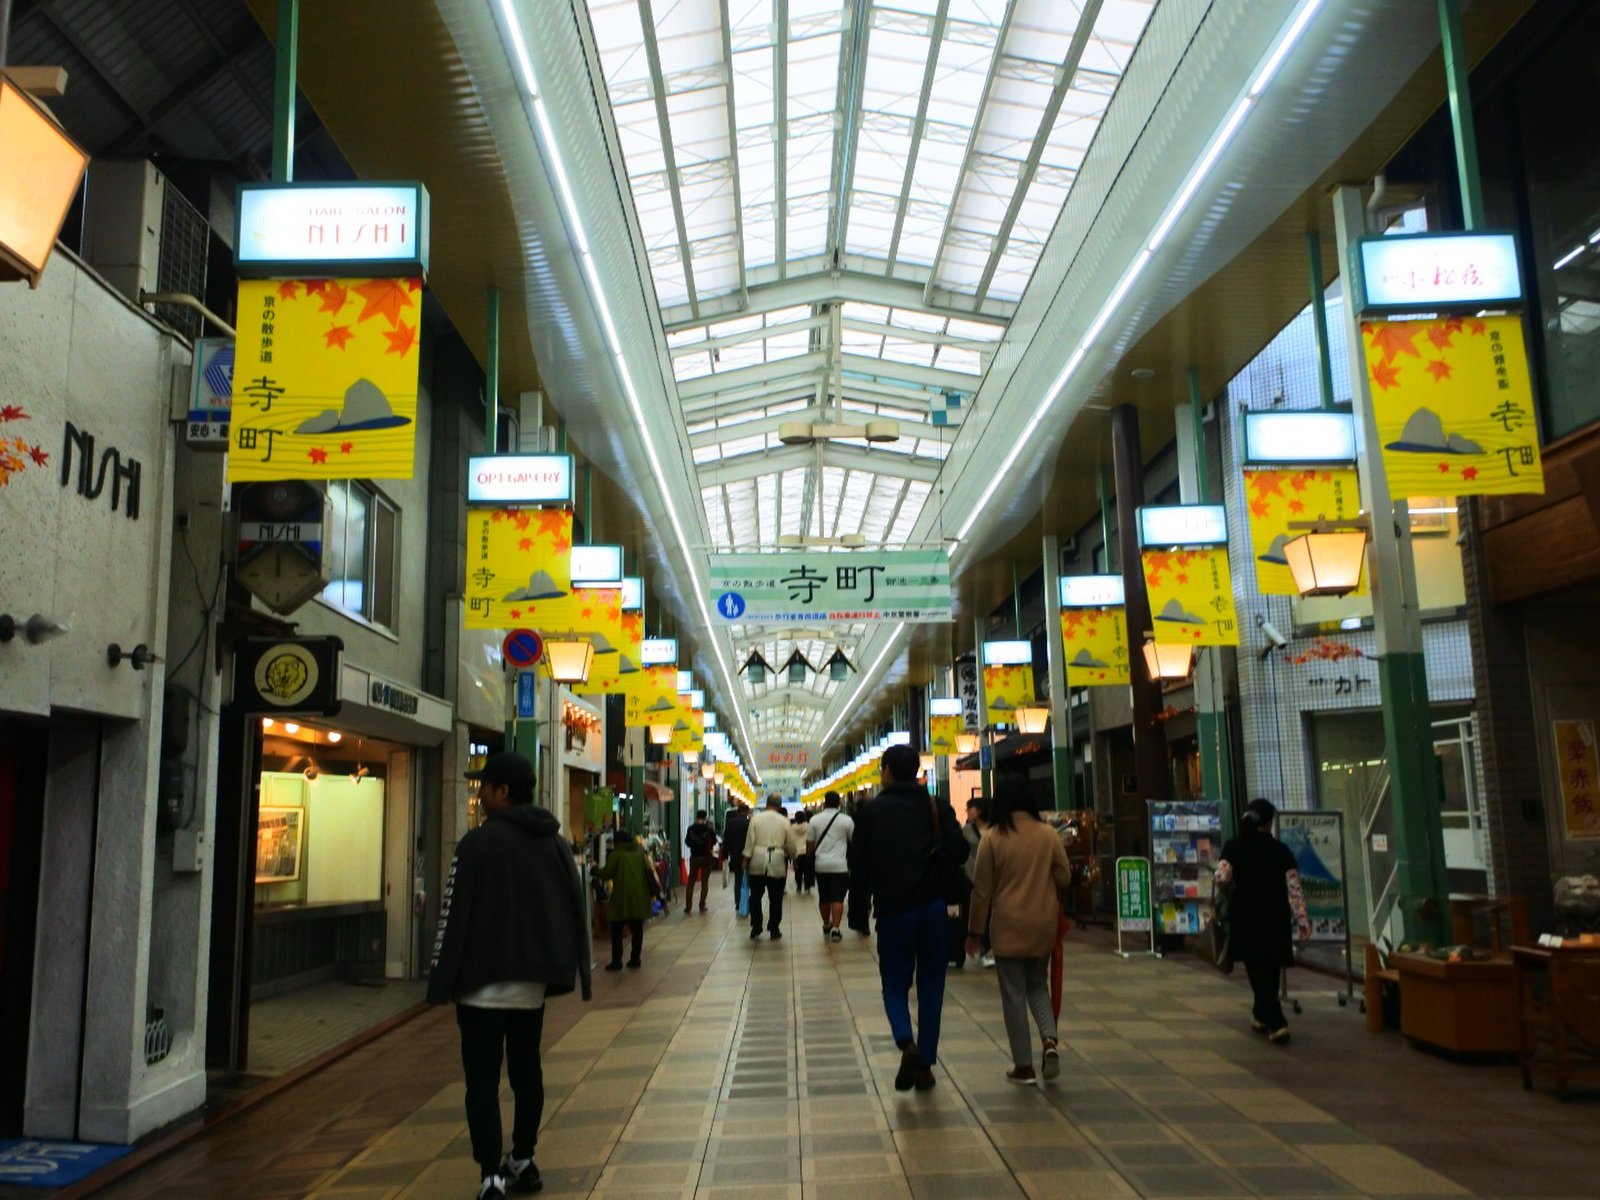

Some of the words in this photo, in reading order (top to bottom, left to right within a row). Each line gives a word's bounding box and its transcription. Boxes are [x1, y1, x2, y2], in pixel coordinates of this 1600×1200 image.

[308, 207, 343, 217] HAIR
[356, 205, 407, 216] SALON
[307, 223, 407, 244] NISHI
[259, 295, 275, 363] 京の散歩道
[239, 375, 285, 462] 寺町
[259, 524, 301, 541] NISHI
[470, 566, 496, 618] 寺町
[722, 579, 775, 588] 京の散歩道
[780, 564, 885, 603] 寺町
